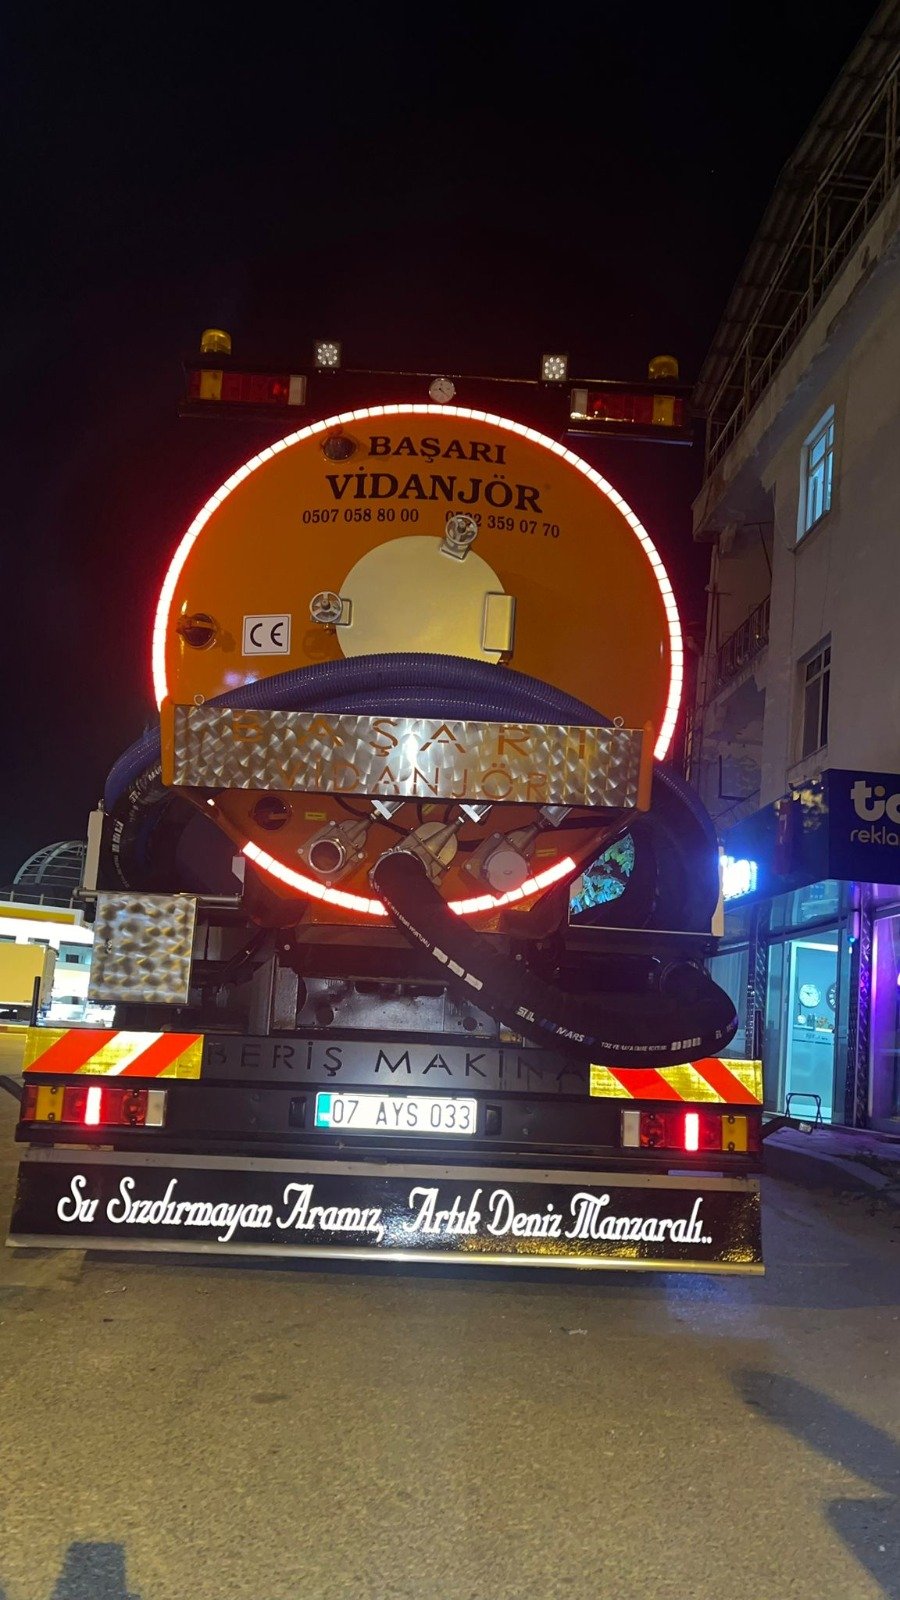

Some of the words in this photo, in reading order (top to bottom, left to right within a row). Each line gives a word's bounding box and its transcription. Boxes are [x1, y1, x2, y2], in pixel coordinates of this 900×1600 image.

[368, 436, 506, 464] BAŞARI
[326, 466, 543, 513] VİDANJÖR
[302, 509, 339, 523] 0507
[344, 509, 372, 522] 058
[377, 508, 396, 522] 80
[401, 508, 419, 522] 00
[487, 515, 514, 531] 359
[520, 520, 537, 534] 07
[542, 523, 560, 538] 70
[250, 622, 283, 647] CE
[231, 712, 586, 760] BAŞARI
[275, 755, 548, 800] VİDANJÖR
[207, 1041, 343, 1077] BERİŞ
[331, 1099, 358, 1125] 07
[376, 1101, 418, 1127] AYS
[430, 1102, 471, 1129] 033
[56, 1174, 100, 1223] Su
[106, 1176, 273, 1242] Sızdırmayan
[402, 1186, 482, 1235] Artık
[486, 1188, 564, 1238] Deniz
